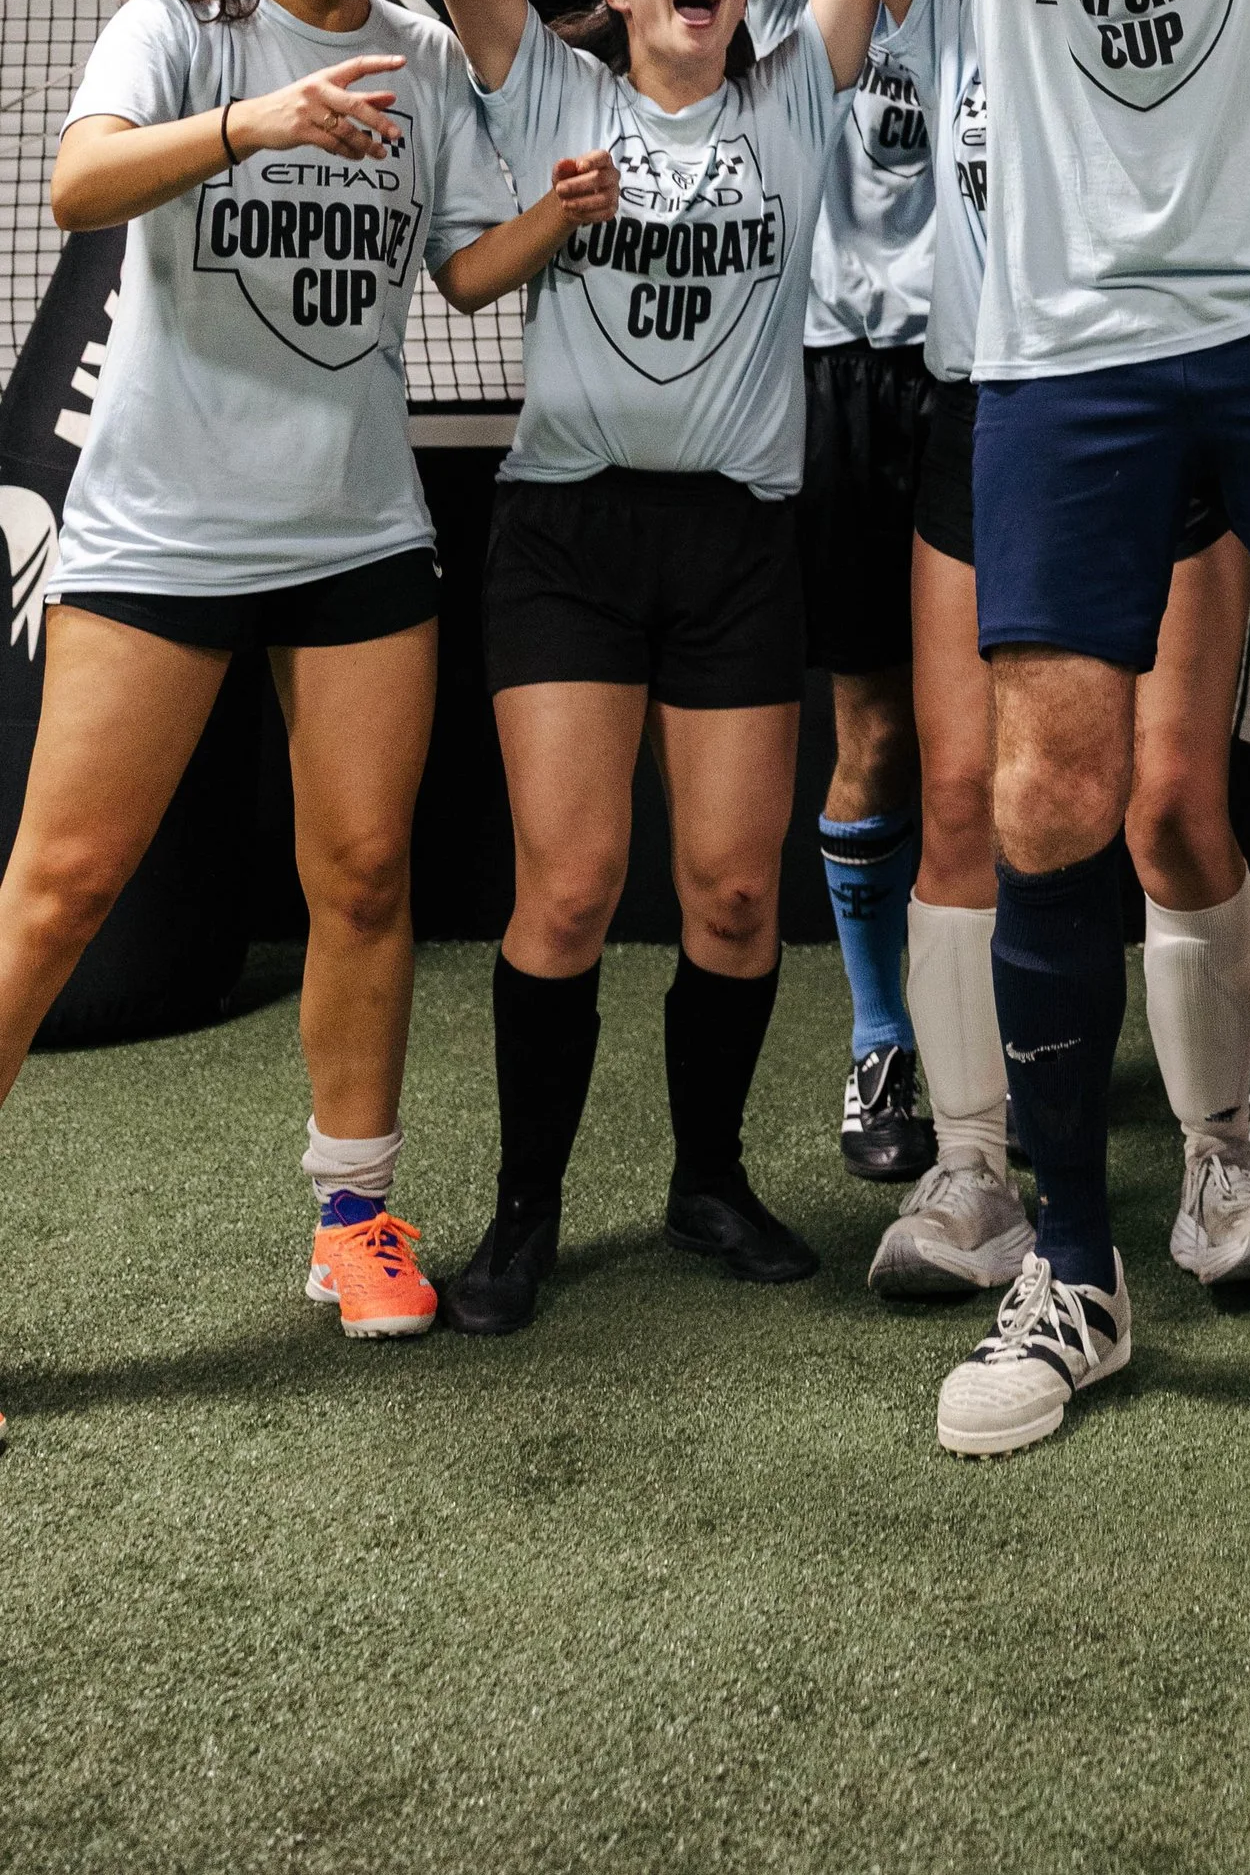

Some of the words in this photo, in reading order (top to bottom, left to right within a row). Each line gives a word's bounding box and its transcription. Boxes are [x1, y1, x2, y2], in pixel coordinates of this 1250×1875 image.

[1097, 11, 1184, 70] CUP
[261, 162, 401, 192] ETIHAD
[567, 212, 776, 278] CORPORATE
[292, 266, 377, 327] CUP
[627, 282, 712, 342] CUP
